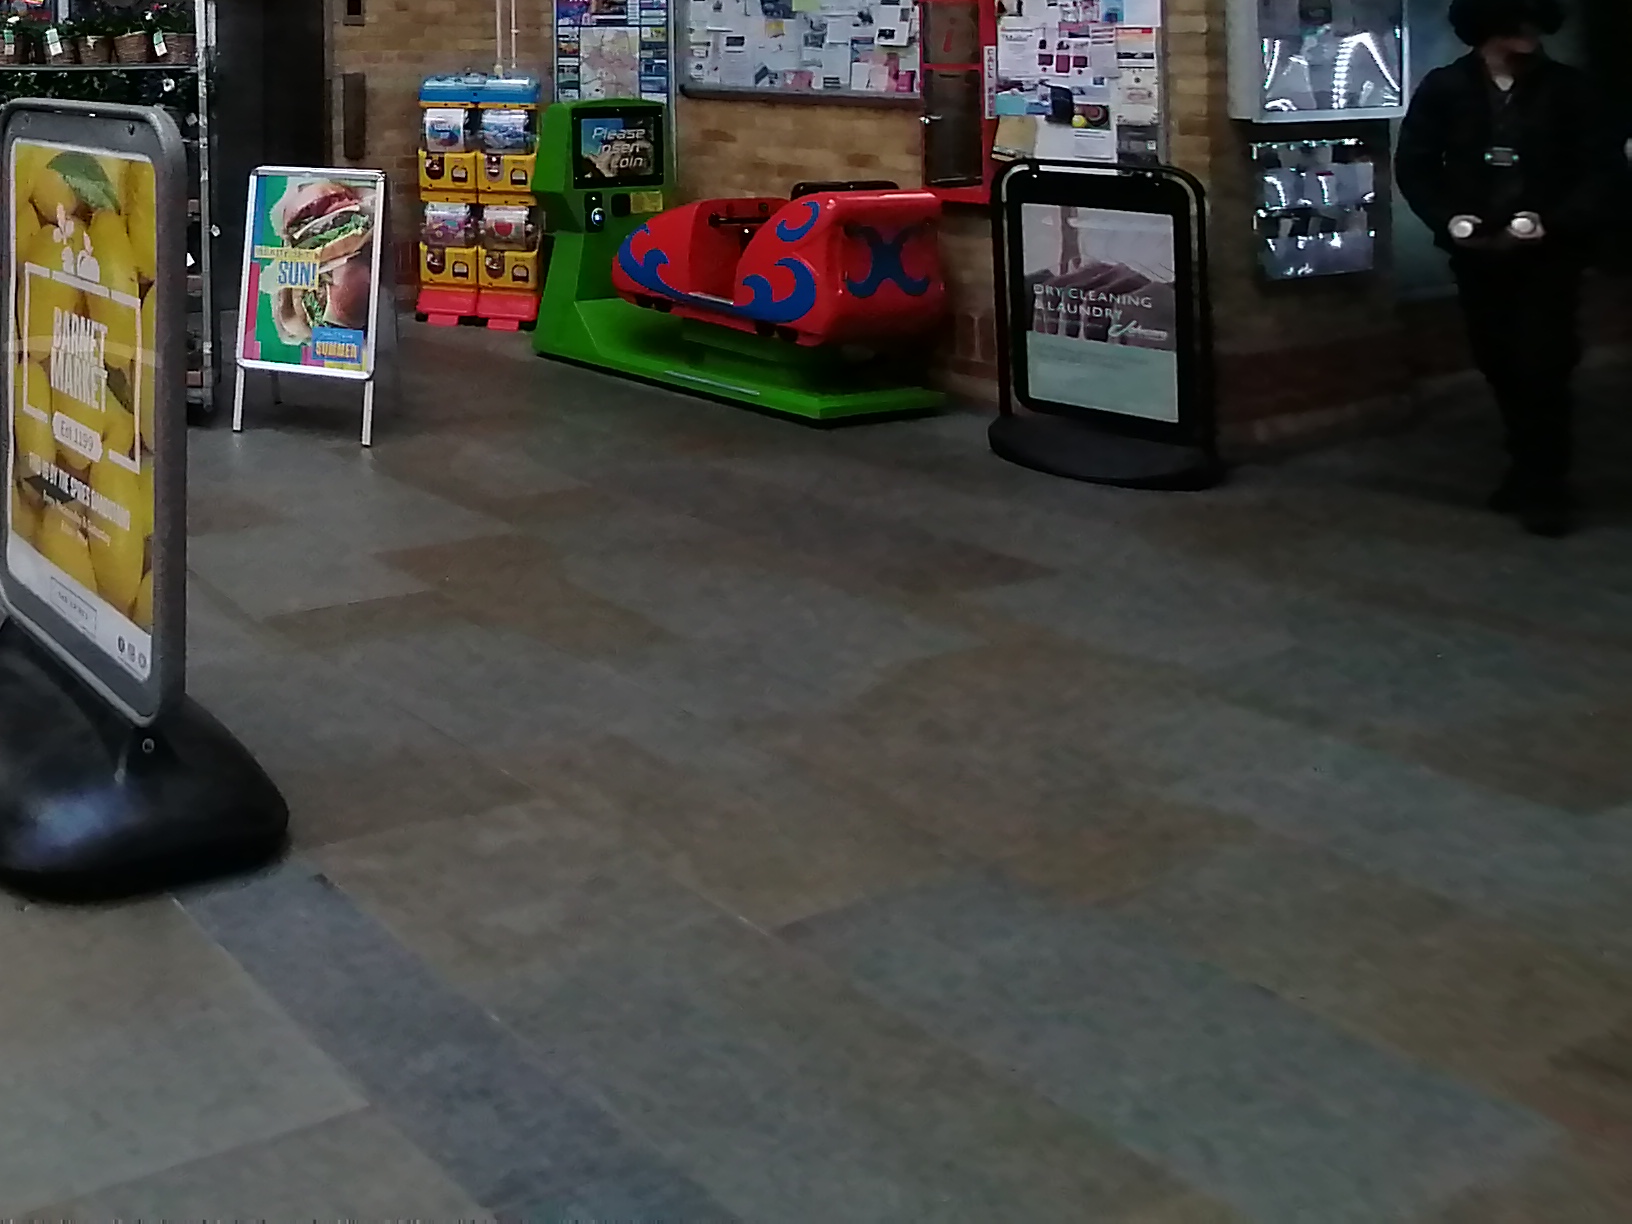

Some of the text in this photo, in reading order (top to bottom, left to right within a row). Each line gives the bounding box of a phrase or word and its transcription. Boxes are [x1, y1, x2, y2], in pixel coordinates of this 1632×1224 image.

[592, 127, 646, 141] Please
[278, 260, 317, 287] SUN!
[1033, 283, 1154, 309] DRY CLEANING
[1047, 301, 1124, 320] LAUNDRY
[52, 306, 109, 368] BARNET
[50, 347, 109, 413] MARKET
